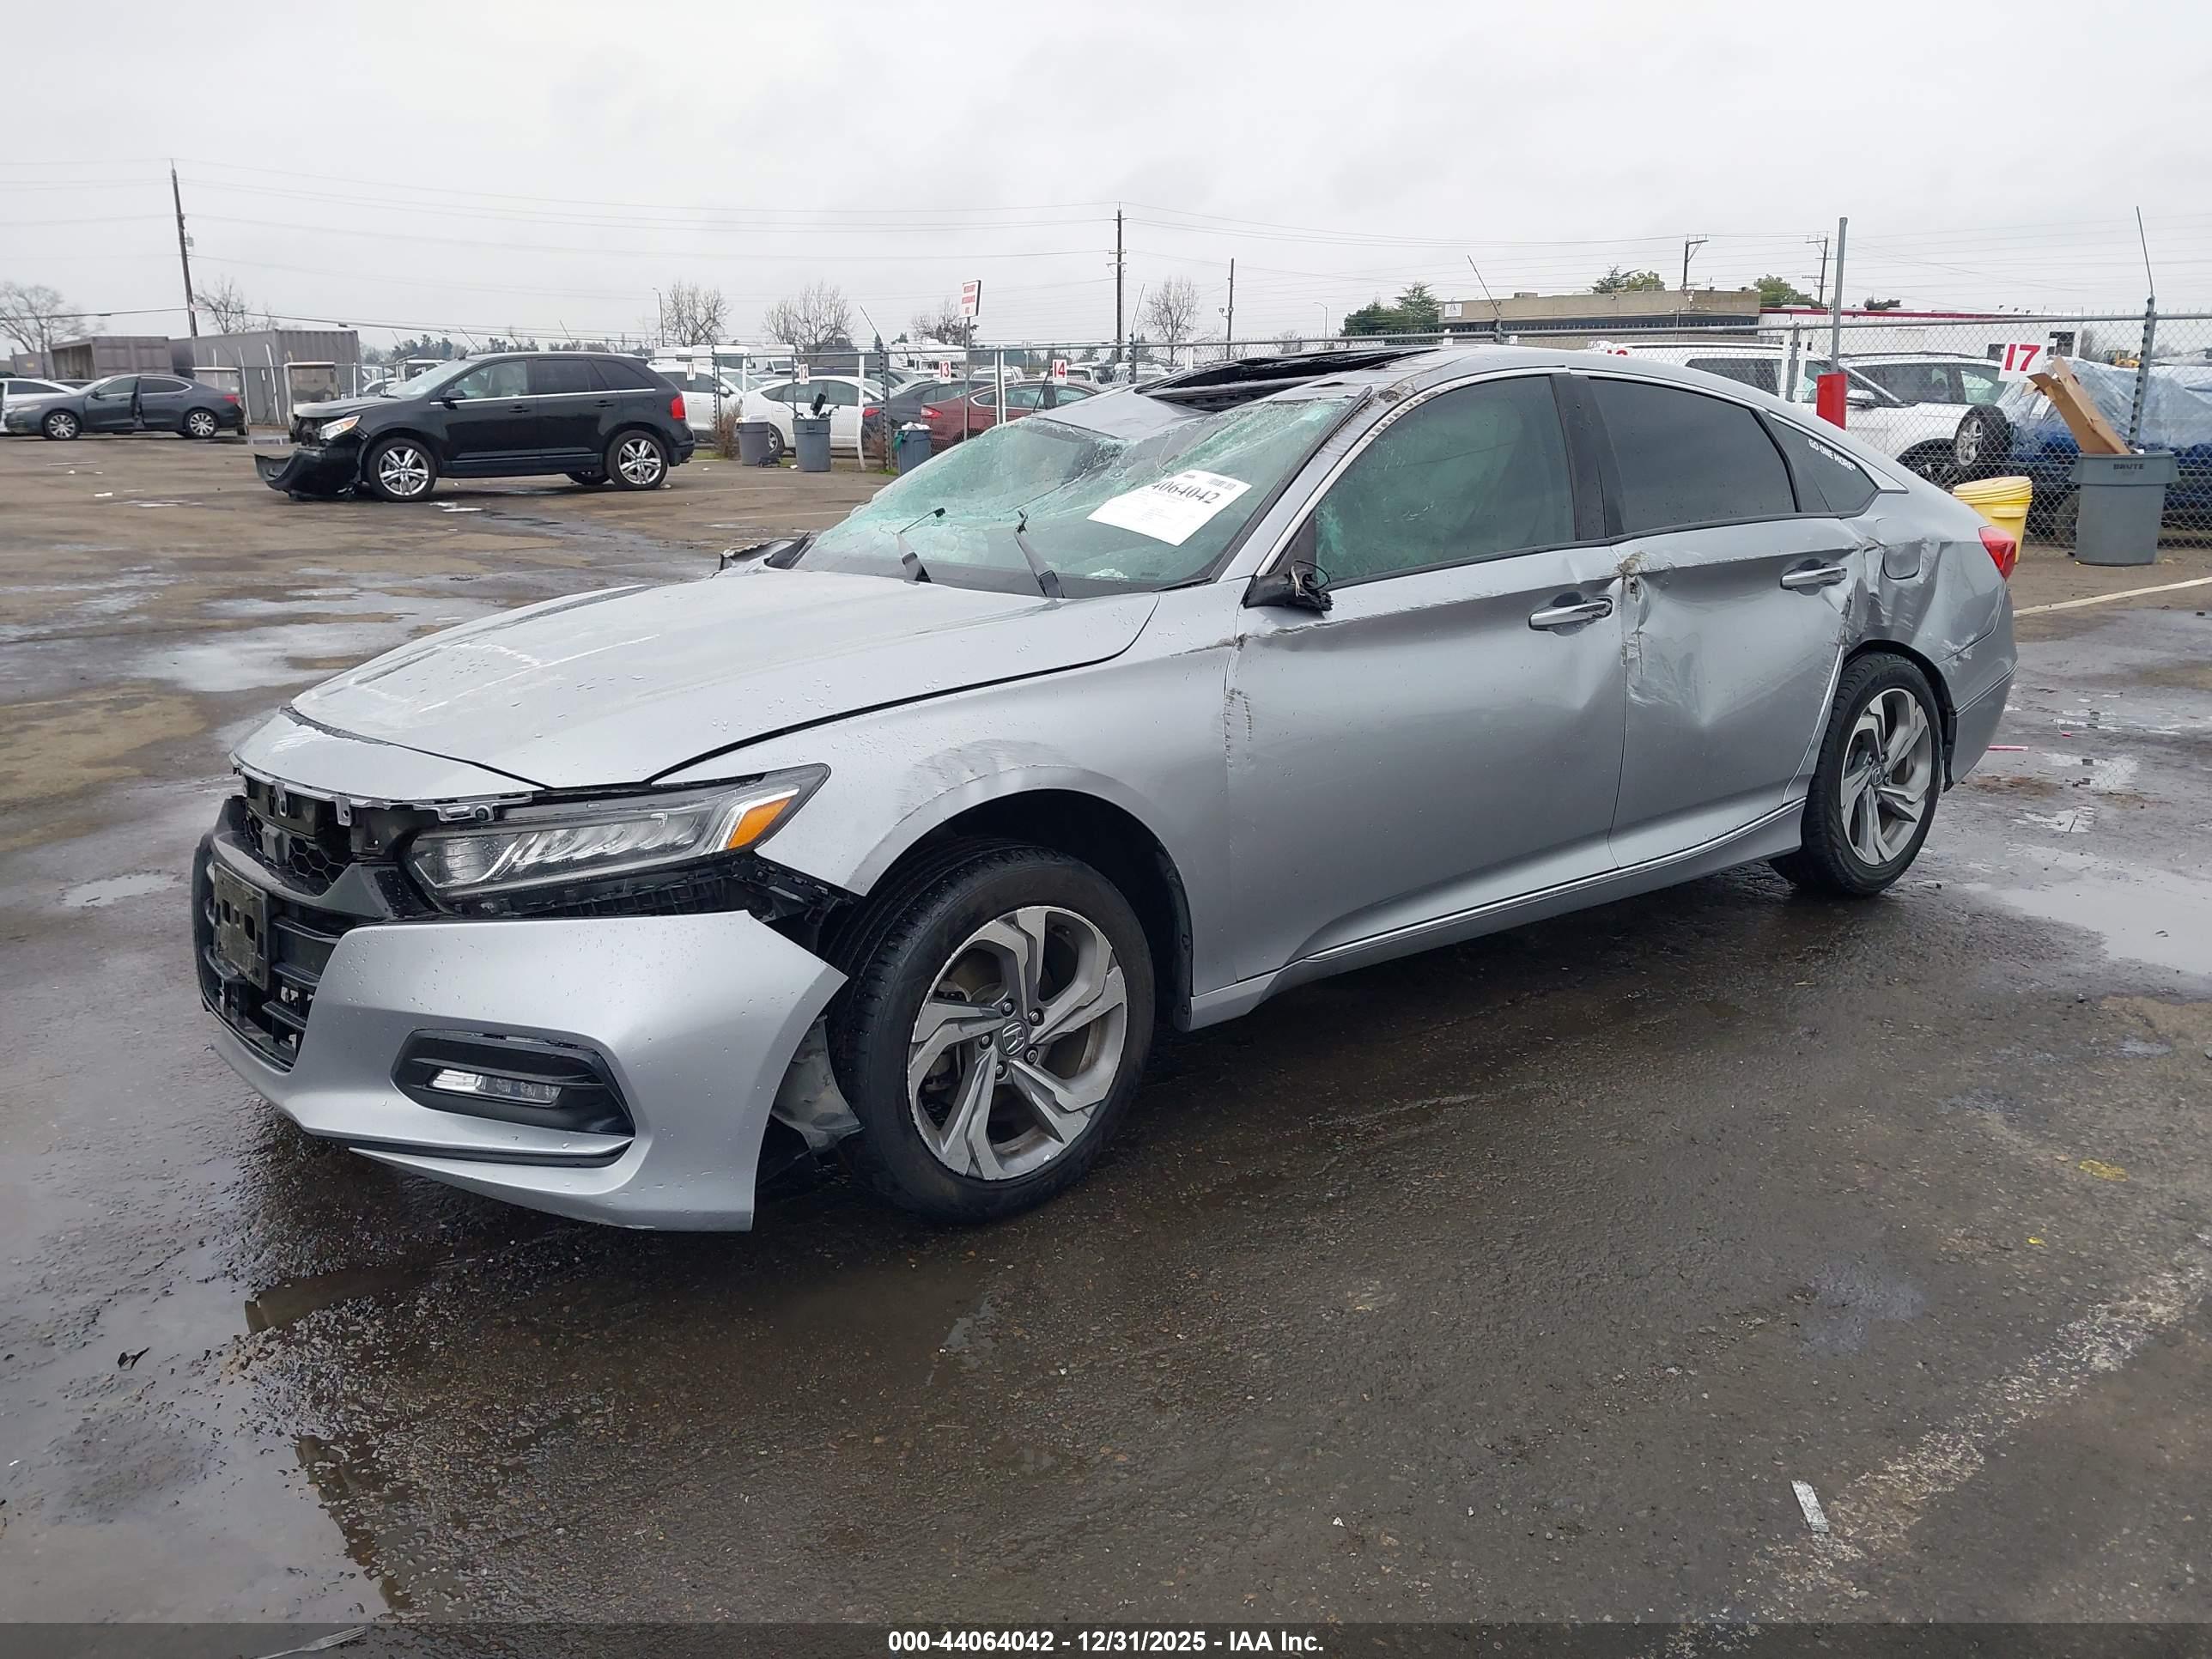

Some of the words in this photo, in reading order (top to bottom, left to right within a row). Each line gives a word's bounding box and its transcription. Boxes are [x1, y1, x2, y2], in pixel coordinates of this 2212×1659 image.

[2004, 343, 2041, 372] 17
[799, 364, 809, 380] 12
[939, 362, 950, 378] 13
[1054, 361, 1066, 379] 14
[1808, 439, 1820, 451] GO
[1819, 445, 1835, 459] ONE
